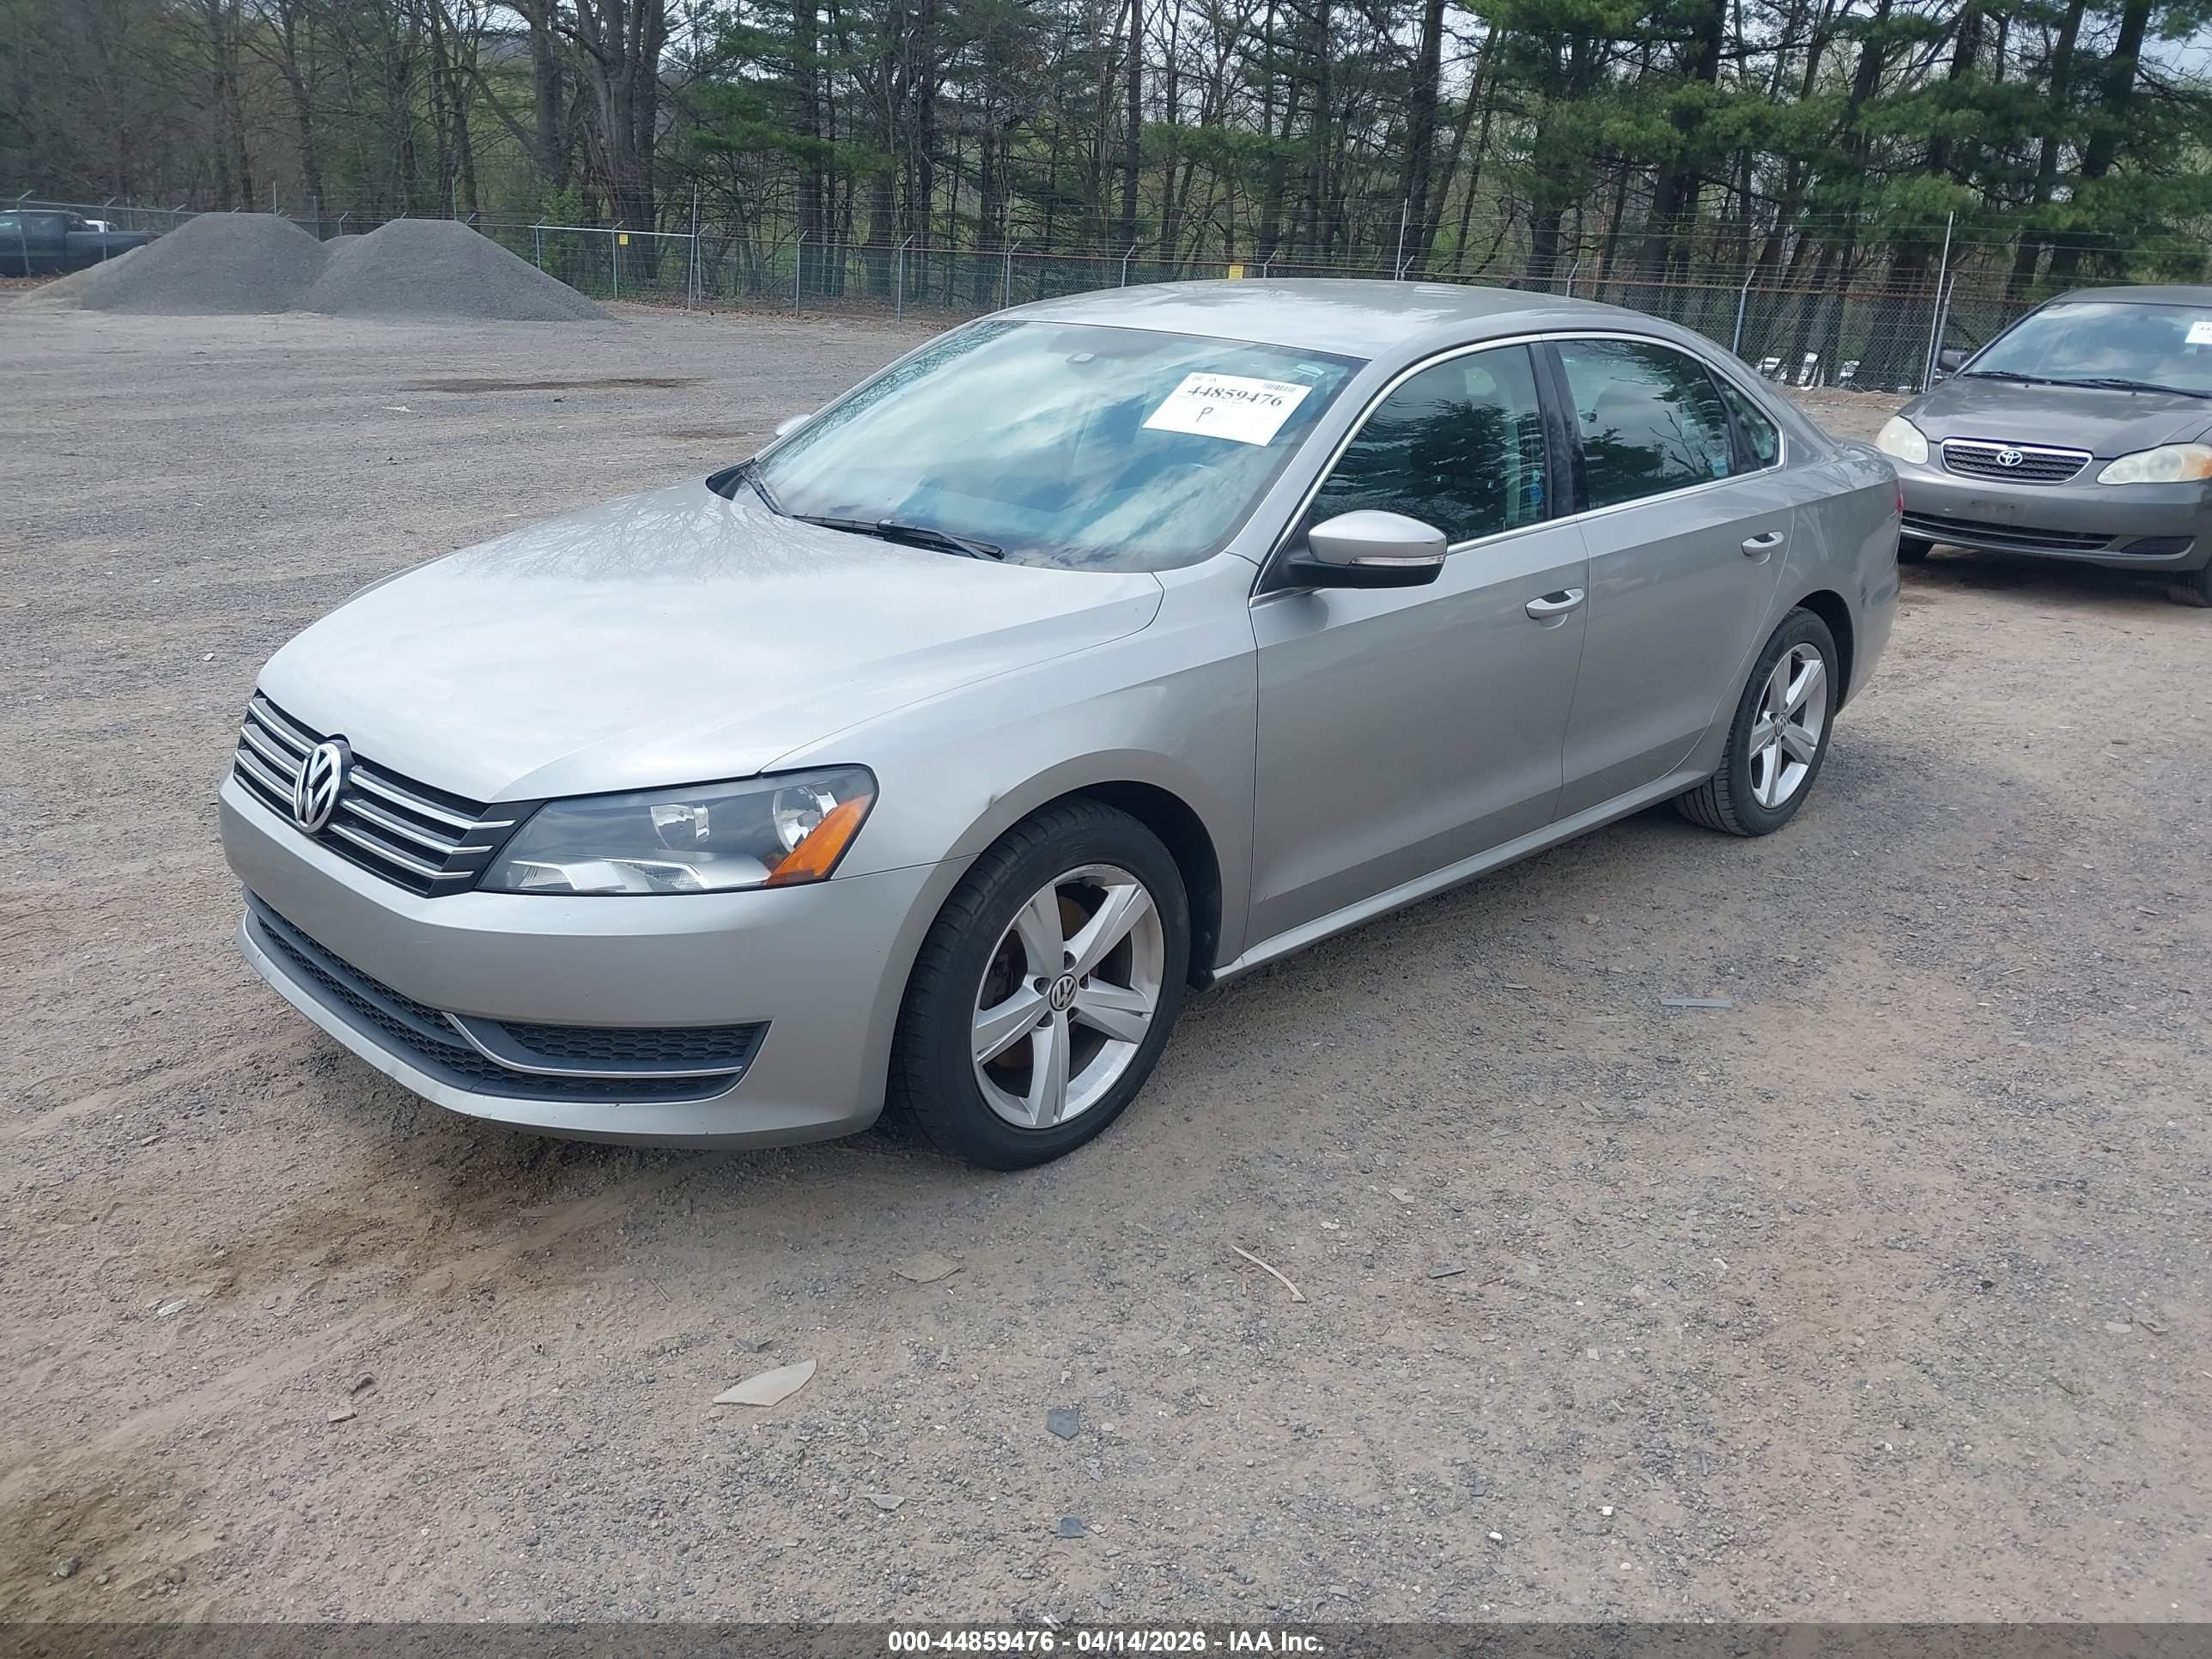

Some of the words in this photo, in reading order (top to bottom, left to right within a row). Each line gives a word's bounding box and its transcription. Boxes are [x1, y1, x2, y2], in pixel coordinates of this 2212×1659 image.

[1187, 385, 1285, 407] 44859476
[1195, 407, 1214, 422] P
[295, 744, 340, 831] VW
[1052, 975, 1076, 1010] VW
